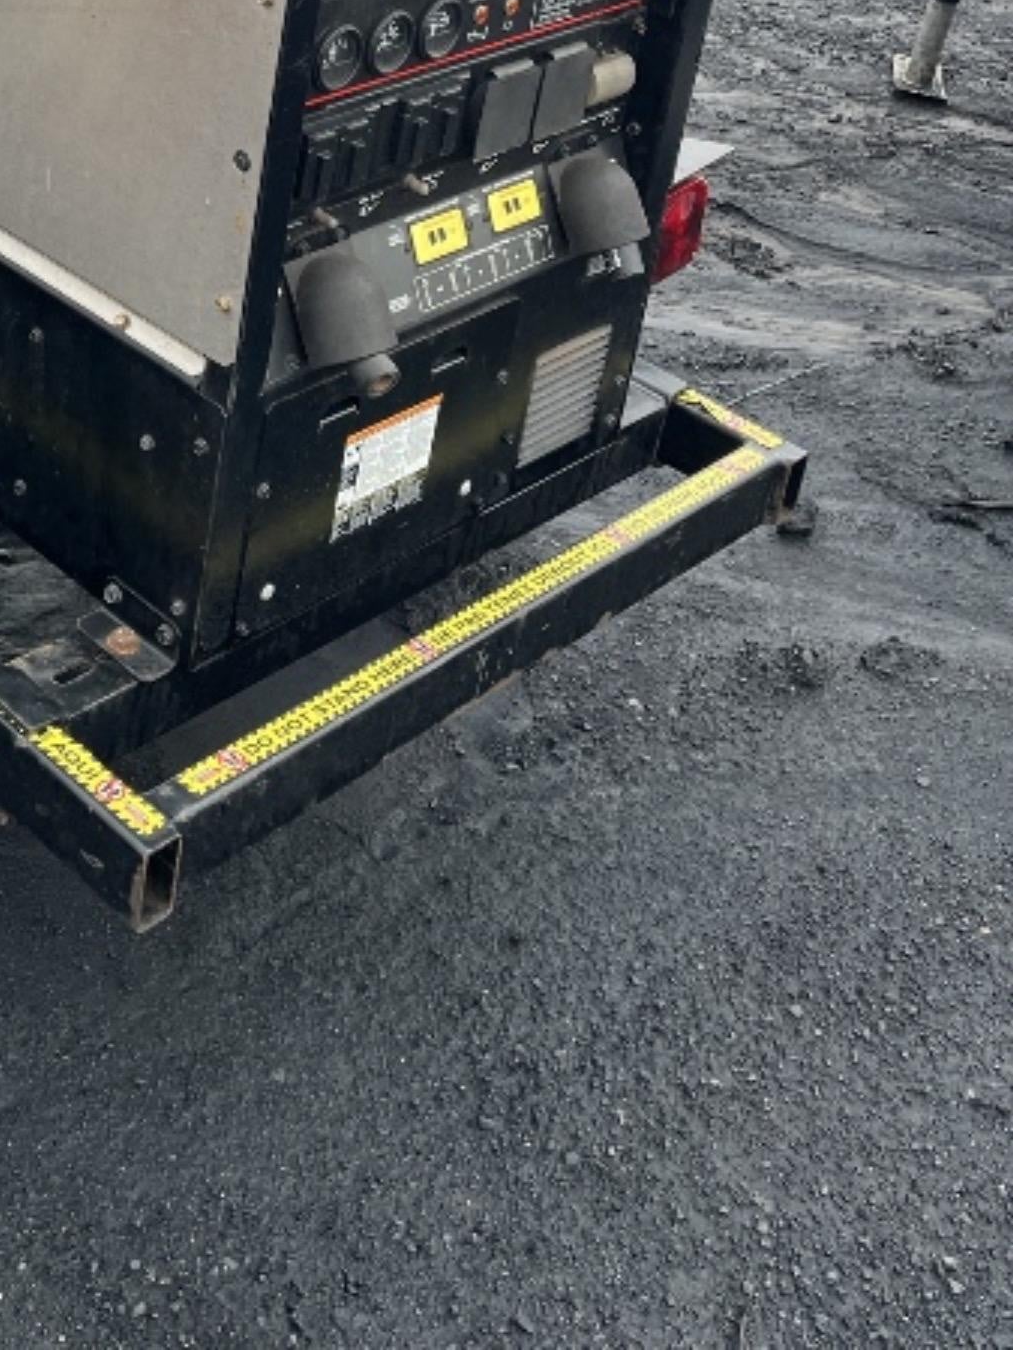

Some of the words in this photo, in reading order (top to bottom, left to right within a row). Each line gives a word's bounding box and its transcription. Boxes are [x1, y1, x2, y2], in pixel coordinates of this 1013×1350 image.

[241, 732, 273, 758] DO
[271, 710, 312, 740] NOT
[309, 676, 371, 717] STAND
